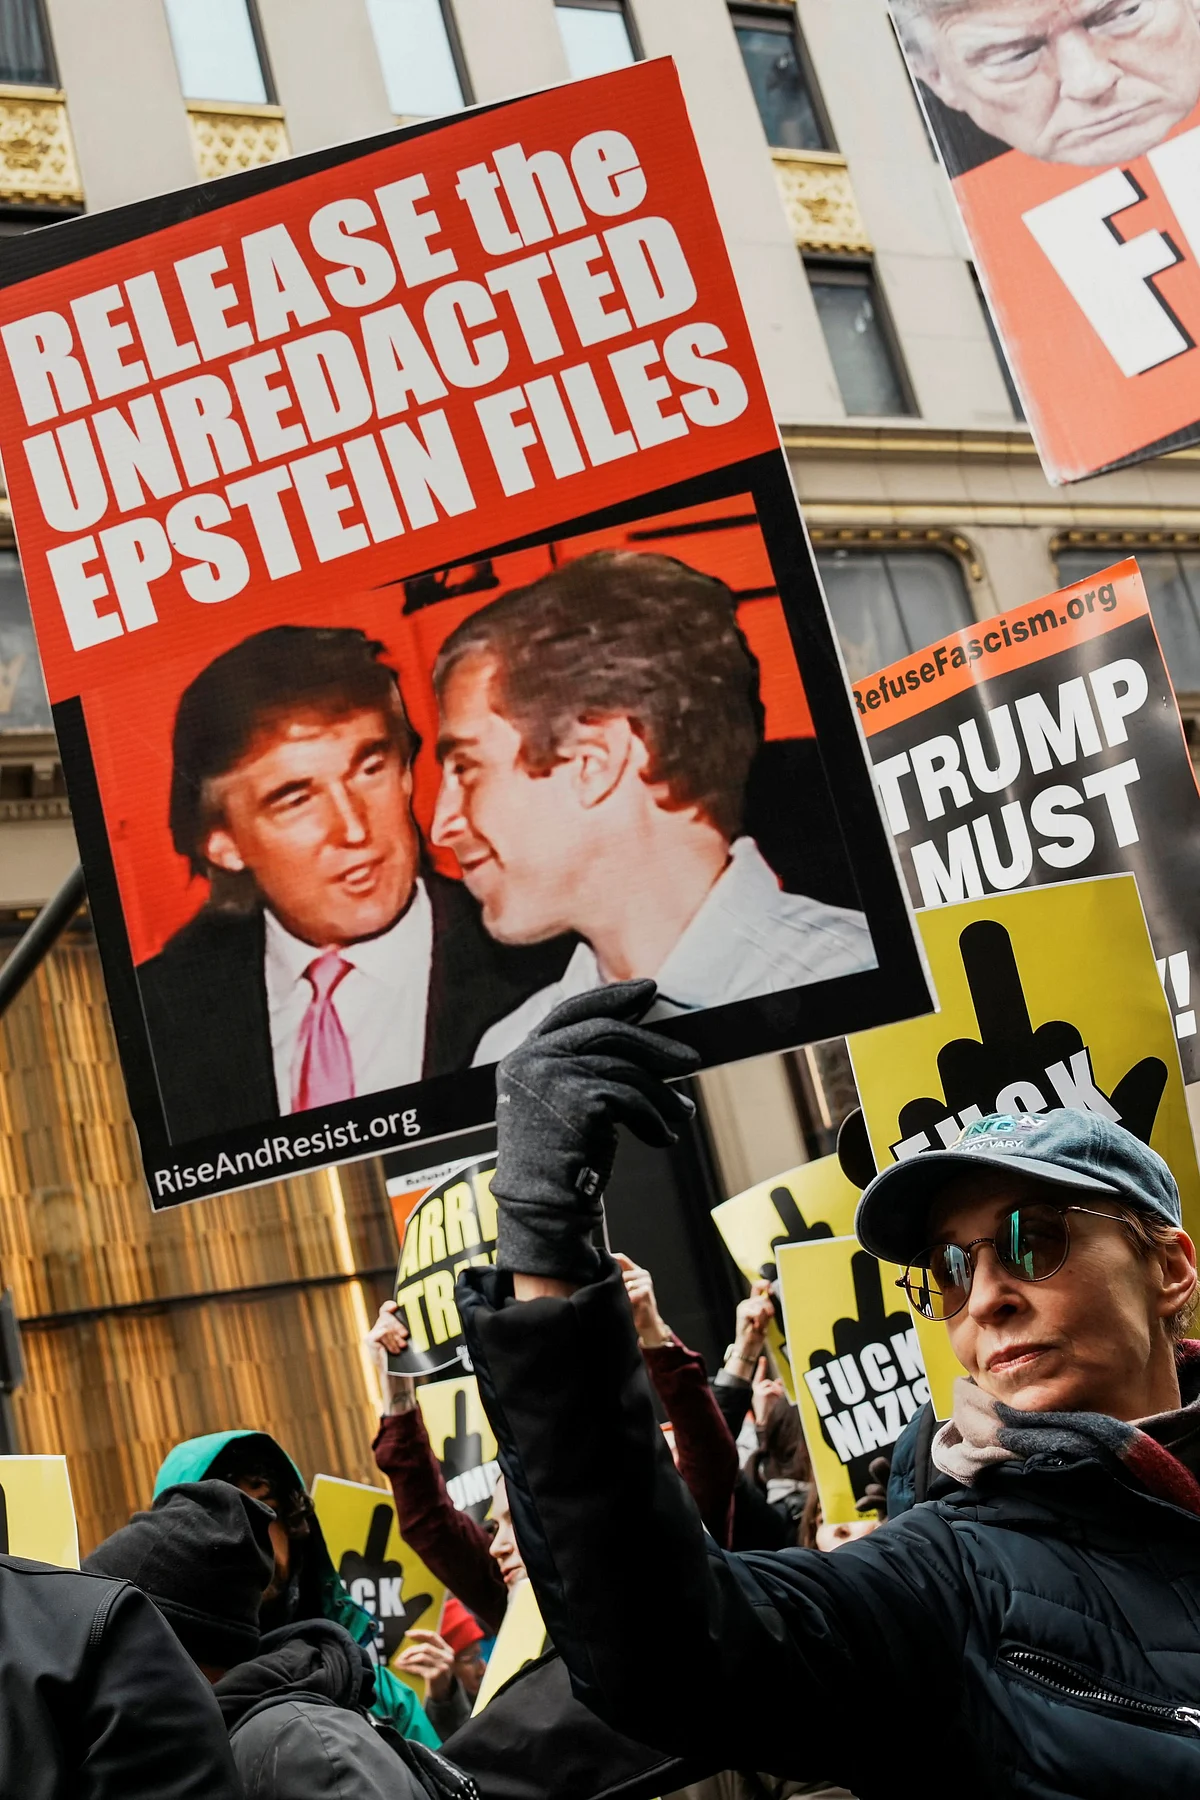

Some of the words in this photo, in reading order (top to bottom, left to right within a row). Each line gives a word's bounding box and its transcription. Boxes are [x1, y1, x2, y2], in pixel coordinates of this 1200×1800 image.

[1, 173, 458, 426] RELEASE
[455, 129, 648, 256] the
[22, 216, 698, 533] UNREDACTED
[46, 408, 477, 652] EPSTEIN
[474, 321, 749, 496] FILES
[853, 582, 1118, 715] RefuseFascism.org
[873, 657, 1149, 836] TRUMP
[911, 758, 1141, 909] MUST
[154, 1108, 421, 1197] RiseAndResist.org
[803, 1327, 927, 1418] FUCK
